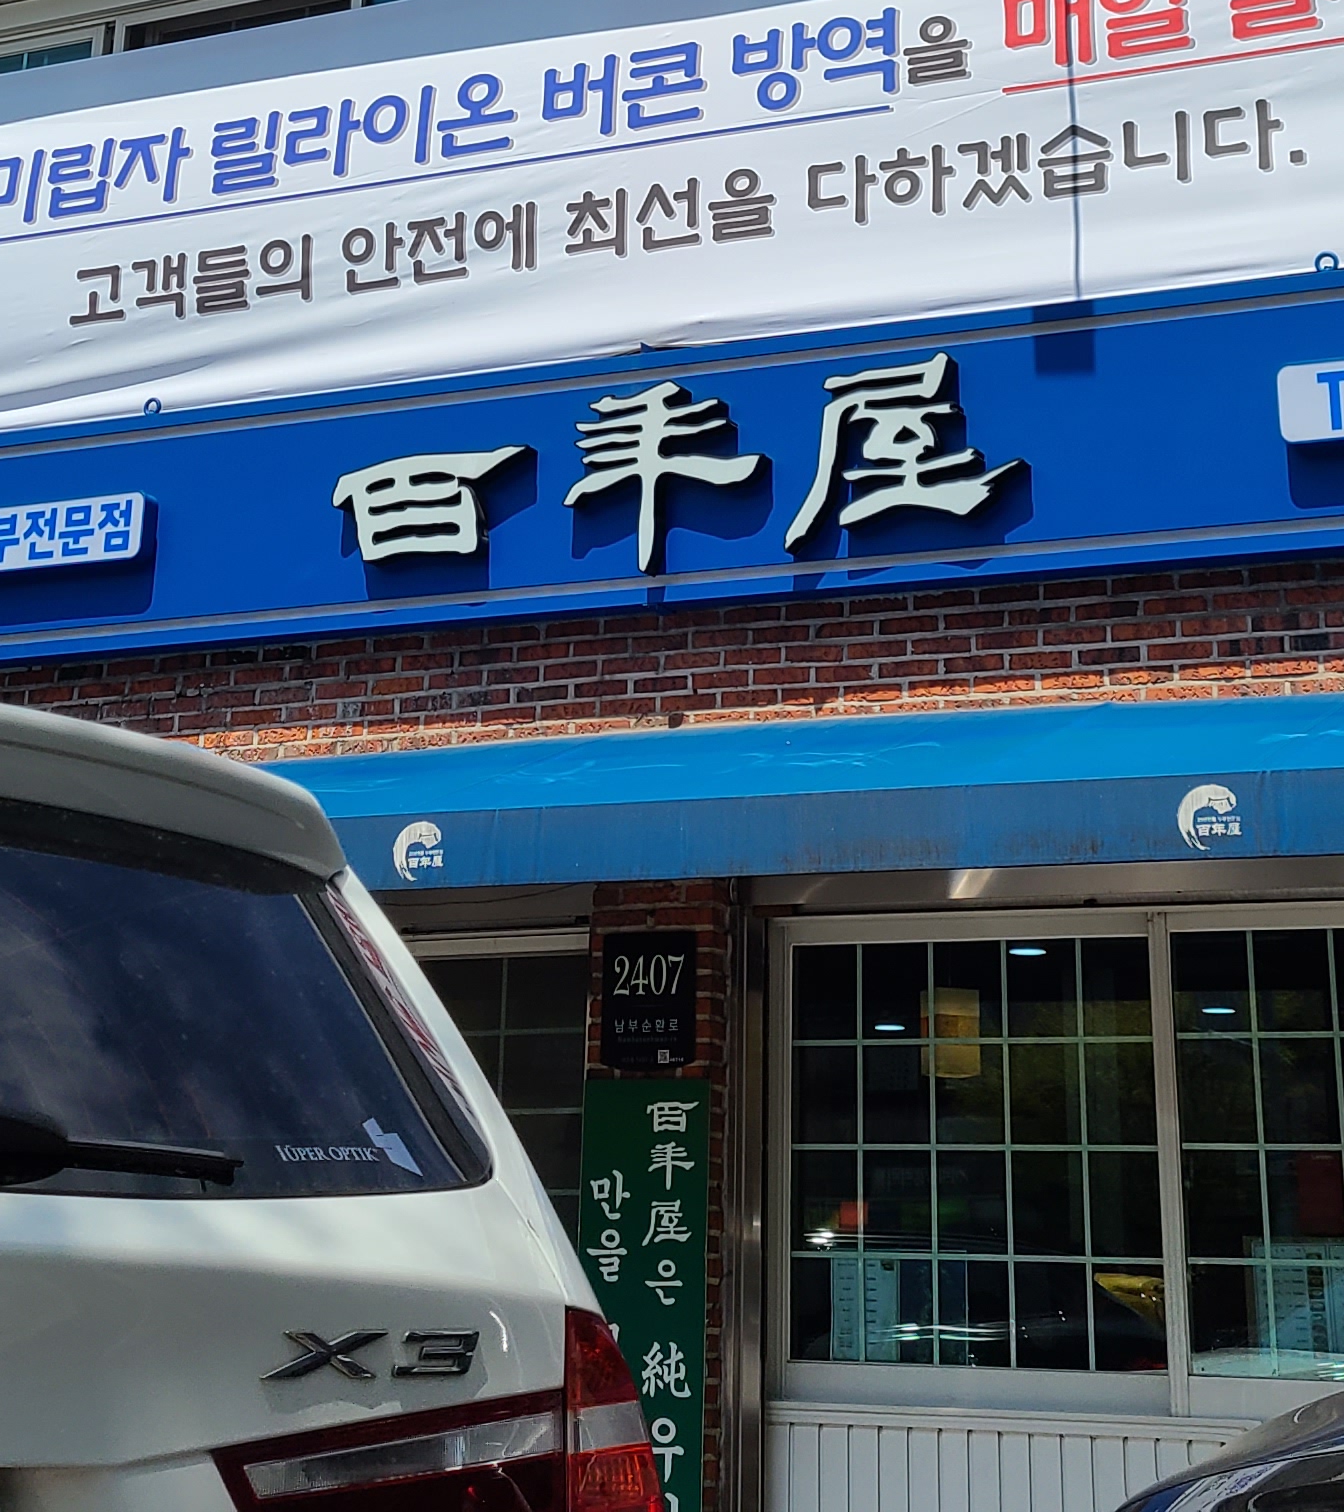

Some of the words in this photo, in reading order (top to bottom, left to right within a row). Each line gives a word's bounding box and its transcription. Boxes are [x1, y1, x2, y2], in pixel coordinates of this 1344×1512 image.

[210, 72, 517, 195] 릴라이온
[541, 41, 706, 137] 버콘
[731, 7, 972, 112] 방역을
[69, 234, 313, 327] 고객들의
[342, 201, 536, 294] 안전에
[563, 167, 775, 258] 최선을
[808, 99, 1308, 225] 다하겠습니다.
[613, 954, 685, 996] 2407
[614, 1018, 679, 1033] 남부순환로
[329, 1147, 380, 1162] OPTIK
[586, 1170, 630, 1282] 만을
[259, 1327, 480, 1378] X3
